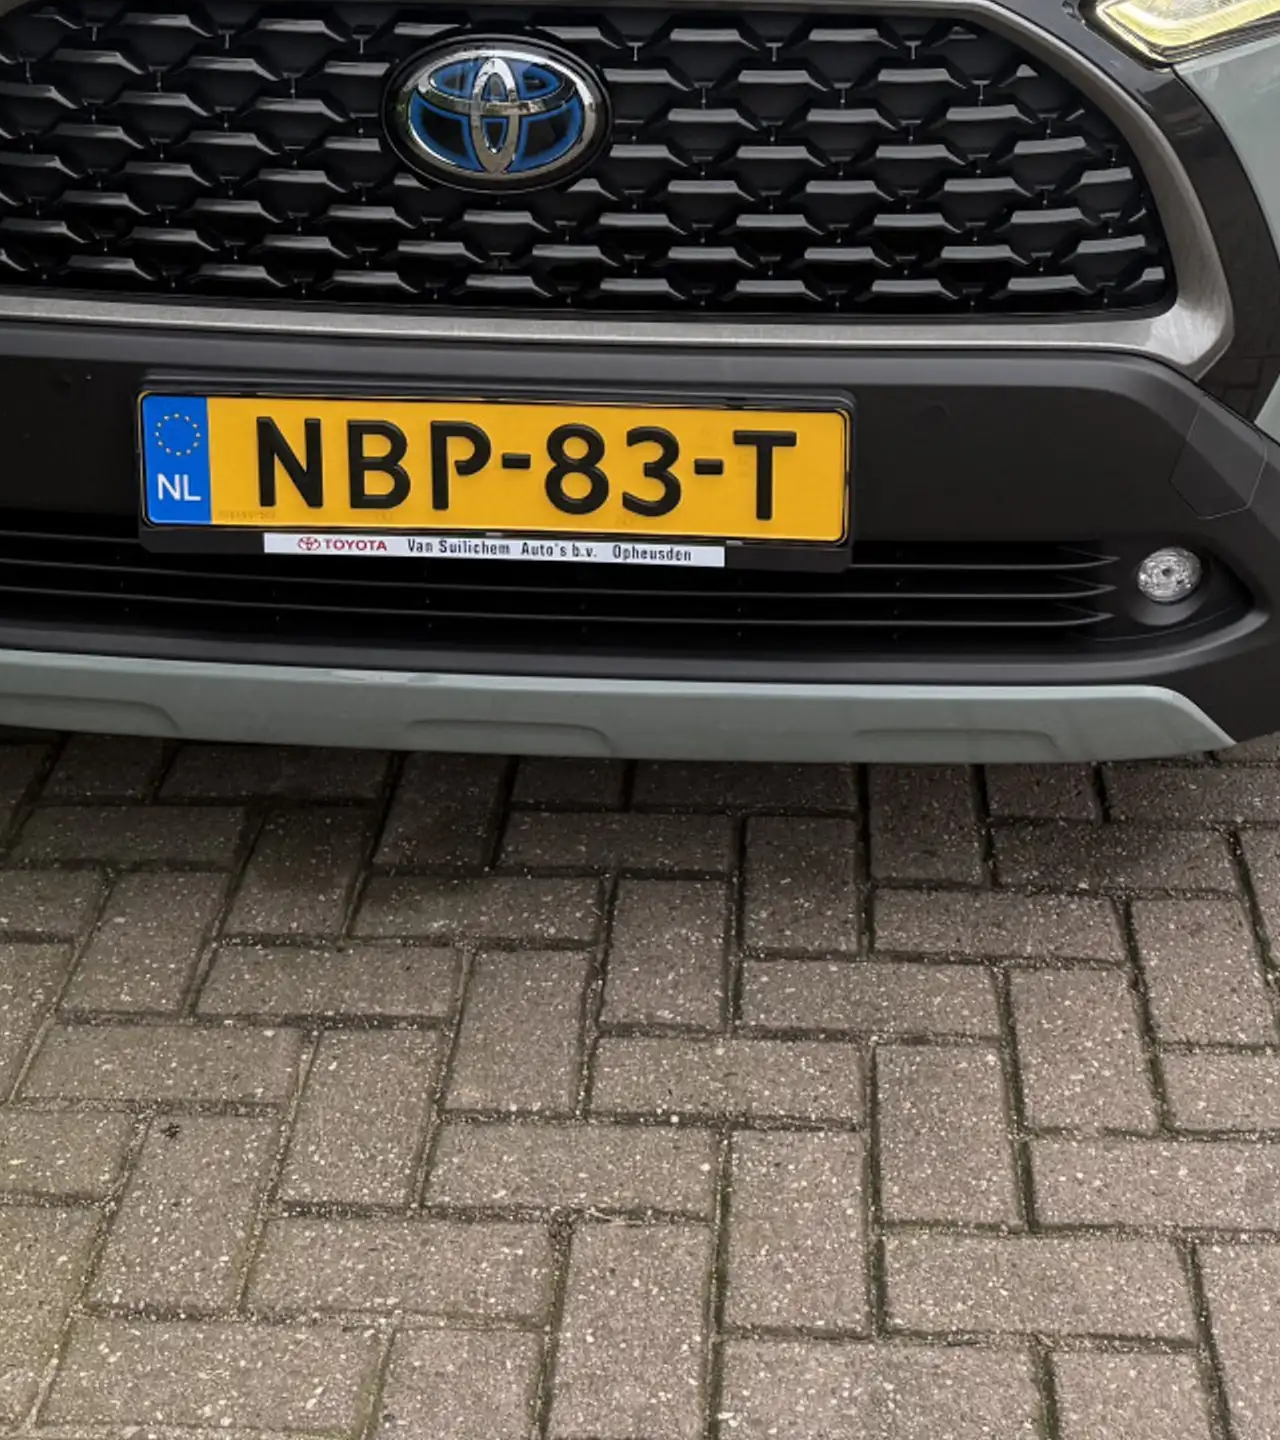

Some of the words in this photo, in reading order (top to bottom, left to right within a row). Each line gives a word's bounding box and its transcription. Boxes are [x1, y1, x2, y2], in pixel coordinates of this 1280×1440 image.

[256, 416, 798, 521] NBP-83-T
[156, 472, 202, 502] NL
[324, 538, 388, 552] TOYOTA
[407, 537, 434, 554] Van
[438, 538, 511, 557] Suilichem
[520, 541, 568, 558] Auto's
[571, 543, 598, 559] b.v.
[612, 544, 693, 562] Opheusden
